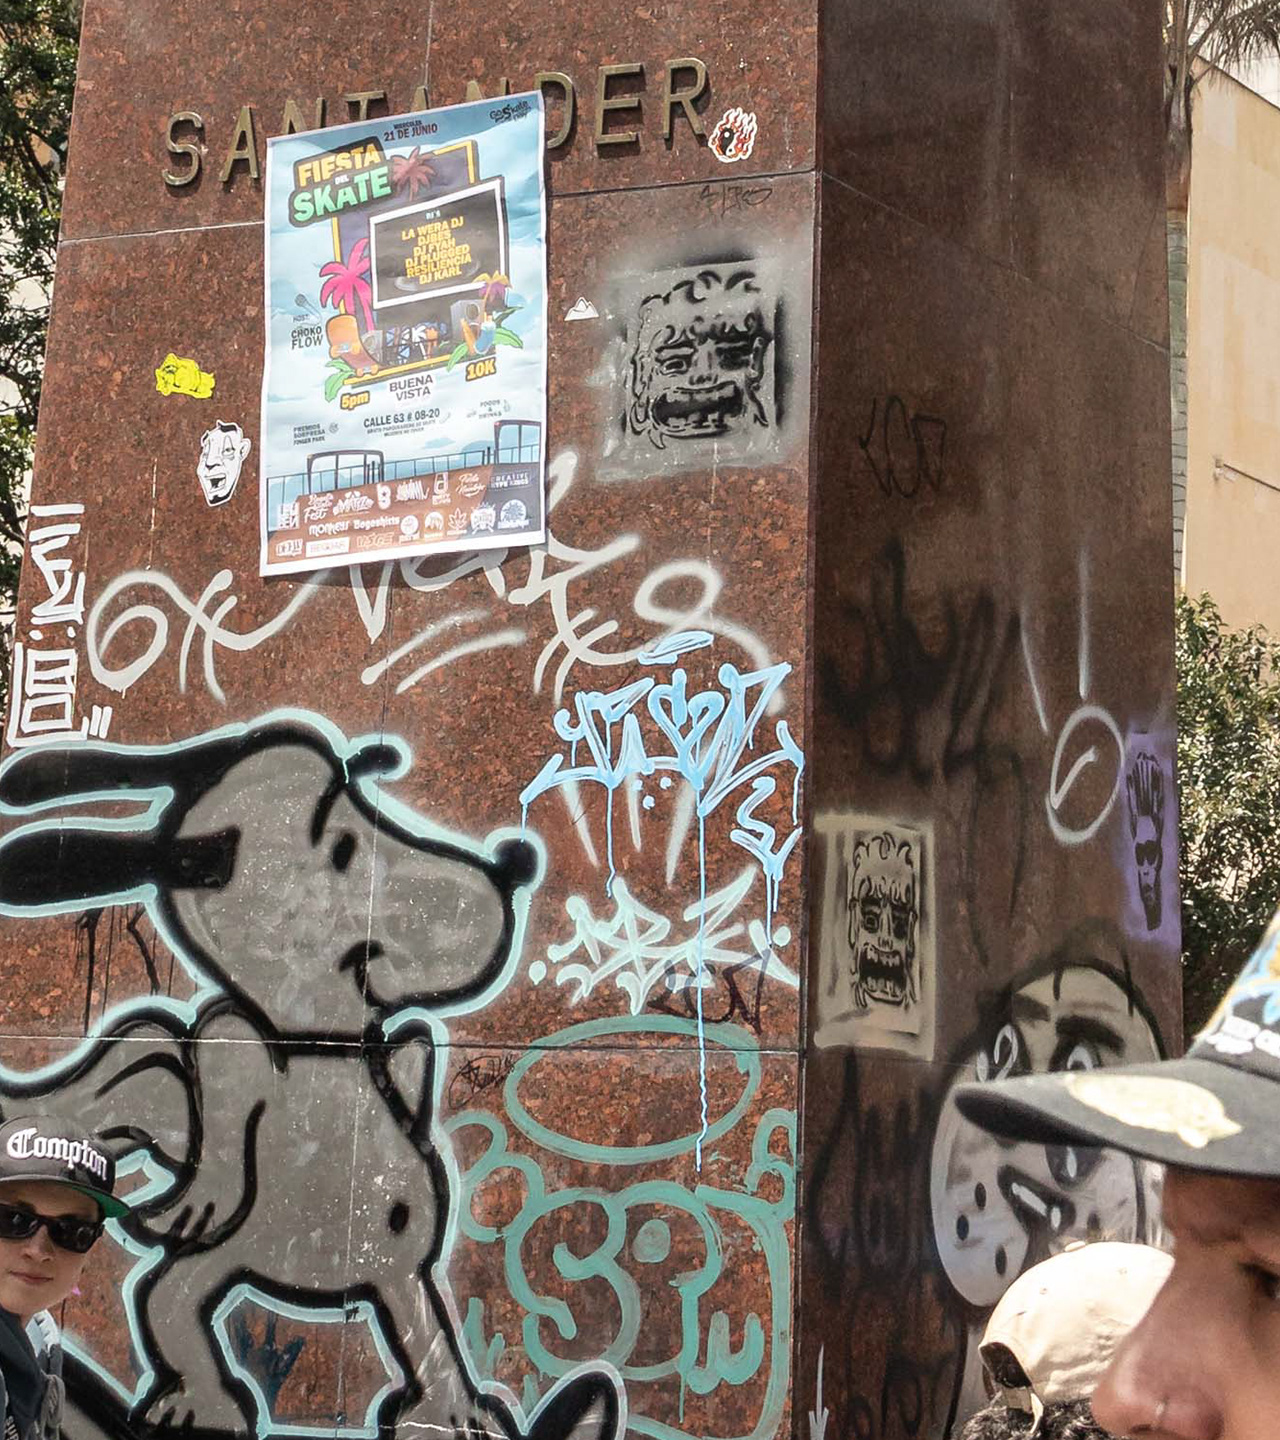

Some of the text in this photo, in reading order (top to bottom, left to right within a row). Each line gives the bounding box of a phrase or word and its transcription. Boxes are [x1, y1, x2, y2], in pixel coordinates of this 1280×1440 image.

[162, 57, 711, 186] SADER
[384, 123, 438, 142] 21 DE JUNIO
[298, 144, 381, 187] FIESTA
[335, 174, 349, 185] DEL
[293, 166, 391, 222] SKATE
[401, 216, 464, 241] LA WERA DJ
[405, 244, 469, 270] DJ PLUGGED
[413, 245, 427, 257] DJ
[407, 253, 471, 279] RESILIENCIA
[420, 266, 462, 284] DJ KARL
[291, 326, 322, 339] CHOKO
[292, 335, 323, 350] FLOW
[466, 359, 496, 380] 10K
[389, 374, 433, 392] BUENA
[341, 391, 370, 410] 5pm
[396, 387, 431, 401] VISTA
[363, 415, 391, 429] CALLE
[393, 413, 404, 424] 63
[6, 1127, 108, 1181] Compton
